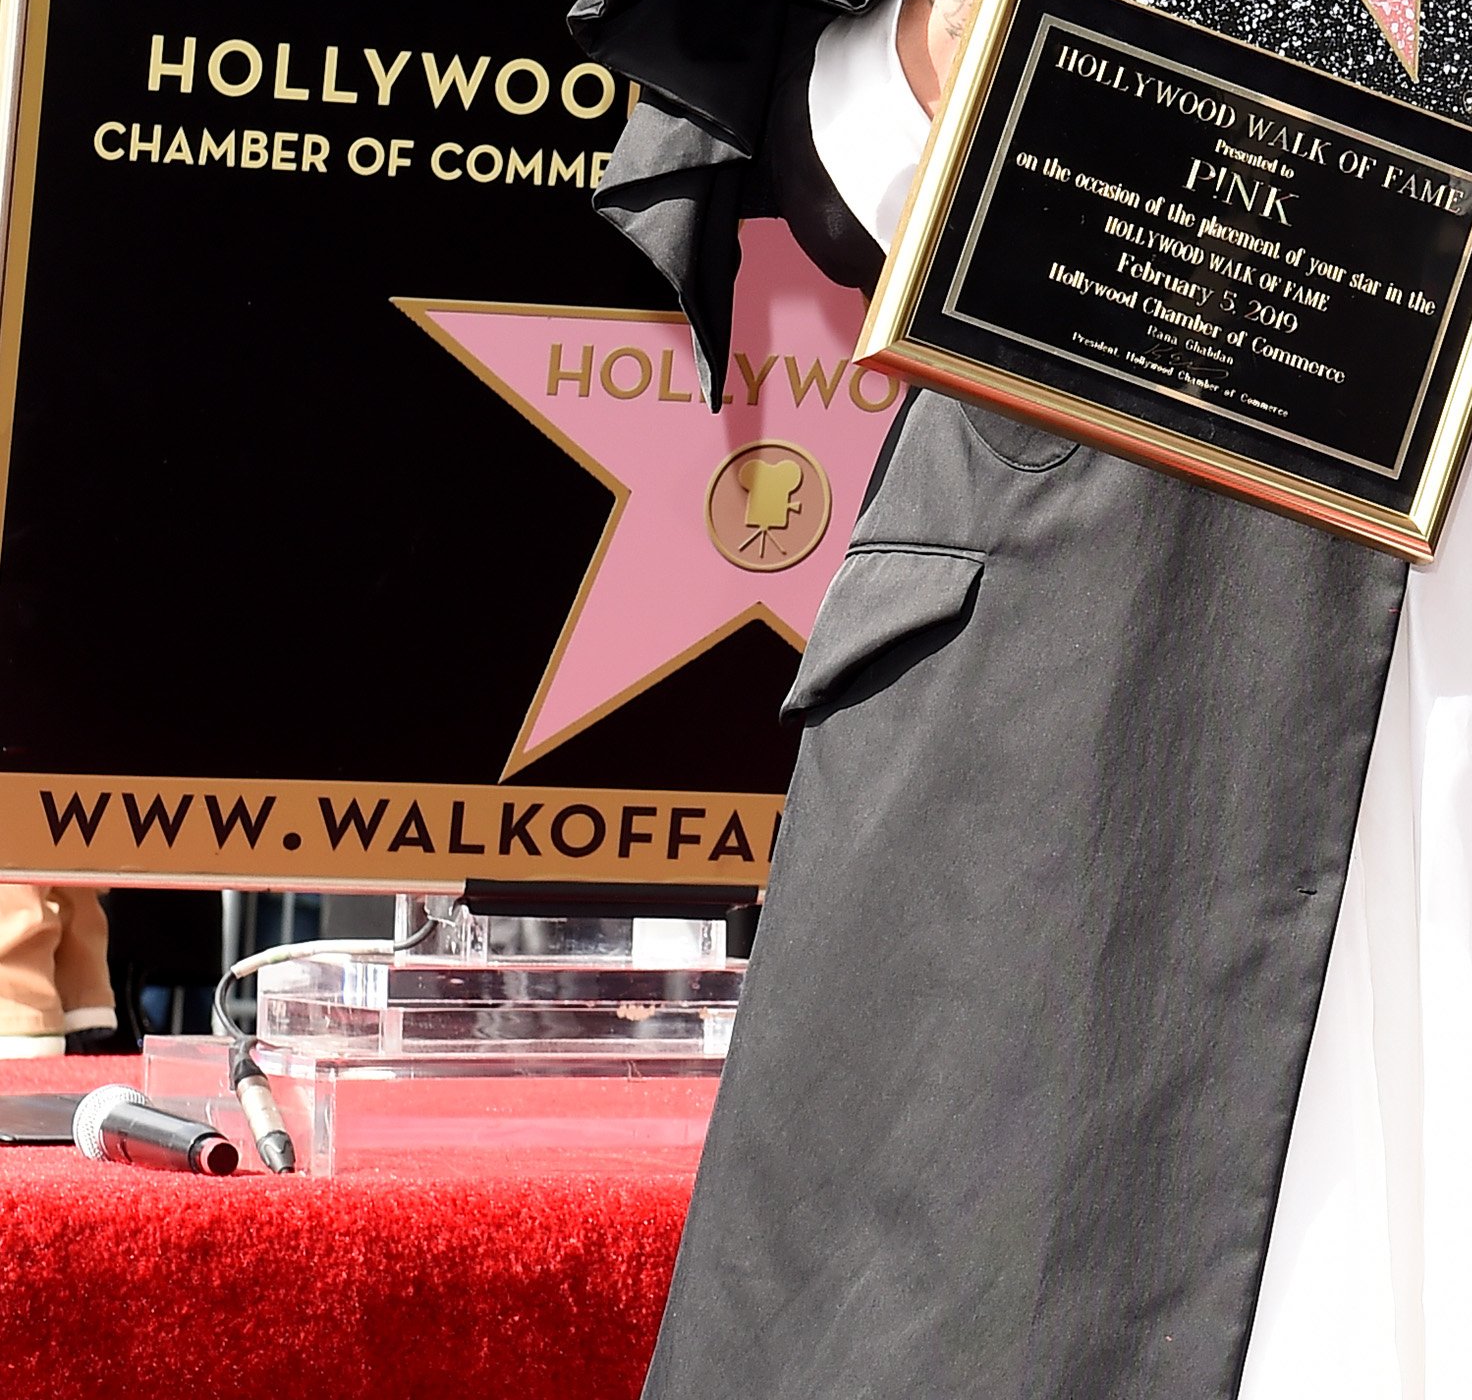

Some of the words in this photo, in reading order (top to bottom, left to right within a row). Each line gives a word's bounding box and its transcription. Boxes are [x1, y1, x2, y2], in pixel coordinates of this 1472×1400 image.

[147, 35, 641, 120] HOLLYWOO
[93, 120, 328, 175] CHAMBER
[347, 136, 415, 179] OF
[1054, 45, 1236, 129] HOLLYWOOD
[1248, 113, 1332, 166] WALK
[1339, 150, 1377, 180] OF
[1381, 165, 1465, 214] FAME
[1214, 139, 1278, 174] Presented
[1280, 163, 1295, 179] to
[1182, 157, 1299, 227] P!NK
[1016, 151, 1038, 171] on
[1043, 157, 1071, 182] the
[1075, 173, 1140, 208] occasion
[1145, 196, 1165, 216] of
[1168, 203, 1196, 228] the
[1197, 215, 1280, 260] placement
[1285, 248, 1306, 267] of
[1305, 257, 1347, 283] your
[1350, 272, 1382, 296] star
[1385, 282, 1403, 305] in
[1408, 291, 1436, 316] the
[1104, 215, 1205, 266] HOLLYWOOD
[1209, 253, 1257, 286] WALK
[1259, 273, 1282, 293] OF
[1283, 280, 1331, 312] FAME
[1048, 262, 1139, 309] Hollywood
[1142, 297, 1222, 339] Chamber
[1227, 330, 1248, 348] of
[1251, 336, 1345, 384] Commerce
[1116, 252, 1214, 306] February
[1244, 300, 1298, 334] 2019
[1147, 324, 1178, 345] Rana
[546, 343, 899, 413] HOLYWO
[1125, 351, 1174, 376] Hollywood
[1178, 371, 1220, 392] Chamber
[1223, 388, 1237, 398] of
[1240, 393, 1289, 418] Commerce
